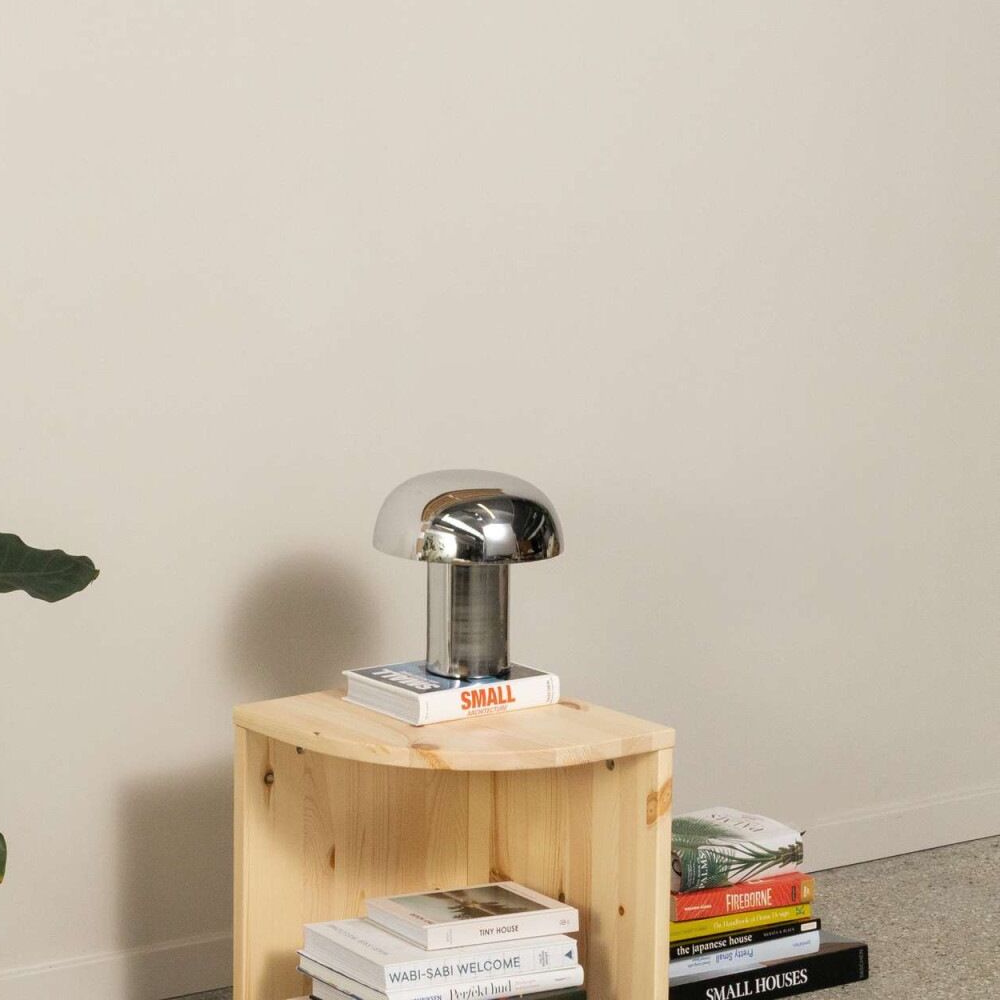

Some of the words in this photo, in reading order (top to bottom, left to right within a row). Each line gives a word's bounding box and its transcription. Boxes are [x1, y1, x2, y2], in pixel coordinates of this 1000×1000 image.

[461, 685, 516, 710] SMALL
[726, 888, 772, 912] FIREBORNE
[479, 928, 494, 936] TINY
[496, 925, 519, 934] HOUSE
[676, 946, 690, 956] the
[692, 940, 727, 954] japanese
[729, 934, 753, 946] house
[388, 967, 454, 983] WABI-SABI
[457, 956, 520, 975] WELCOME
[706, 980, 753, 1000] SMALL
[755, 968, 808, 994] HOUSES
